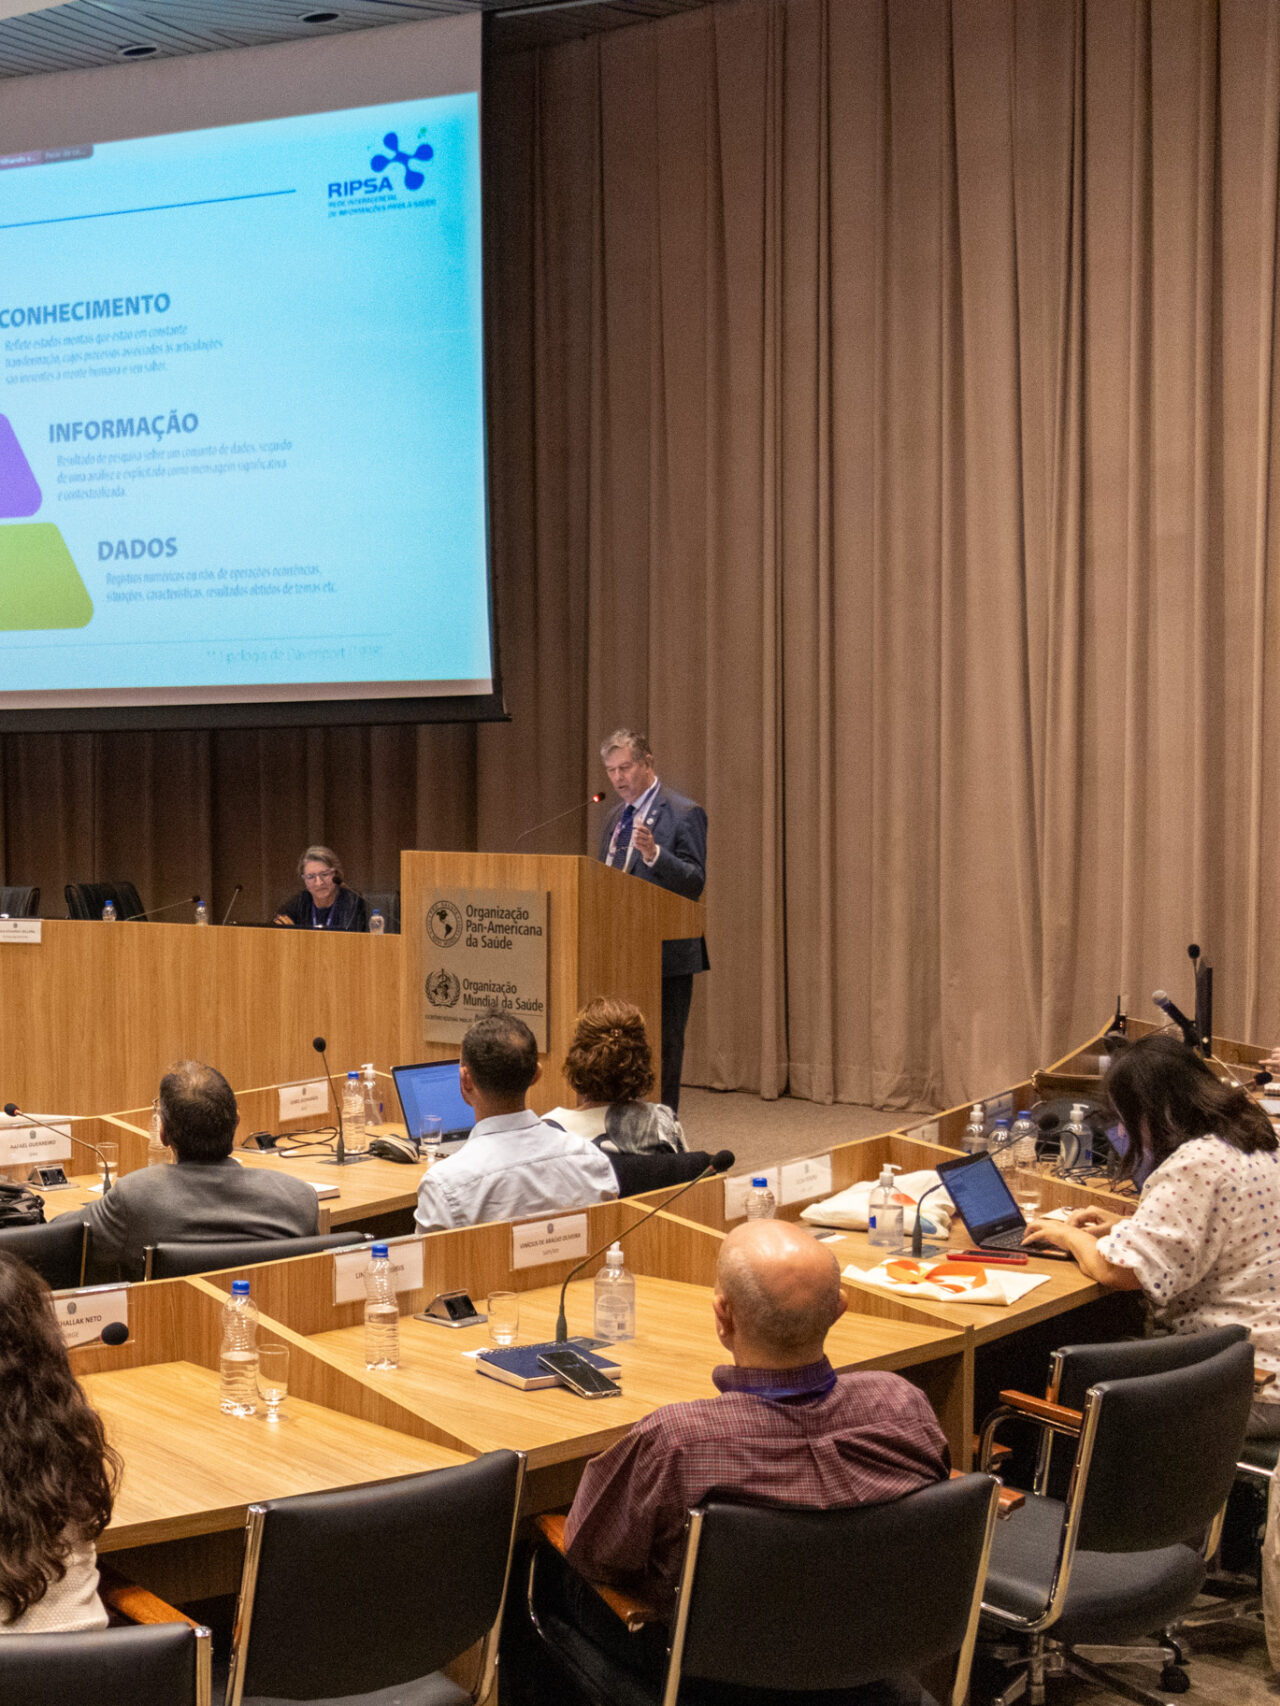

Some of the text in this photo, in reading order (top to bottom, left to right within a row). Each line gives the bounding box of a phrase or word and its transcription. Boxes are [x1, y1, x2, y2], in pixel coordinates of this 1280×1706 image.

[328, 177, 393, 198] RIPSA
[49, 410, 199, 442] INFORMAÇÃO
[98, 537, 178, 561] DADOS
[465, 904, 529, 922] Organização
[466, 920, 542, 936] Pan-Americana
[466, 935, 513, 950] da Saúde
[462, 978, 517, 995] Organização
[463, 994, 544, 1012] Mundial da Saúde
[85, 1315, 102, 1323] NETO
